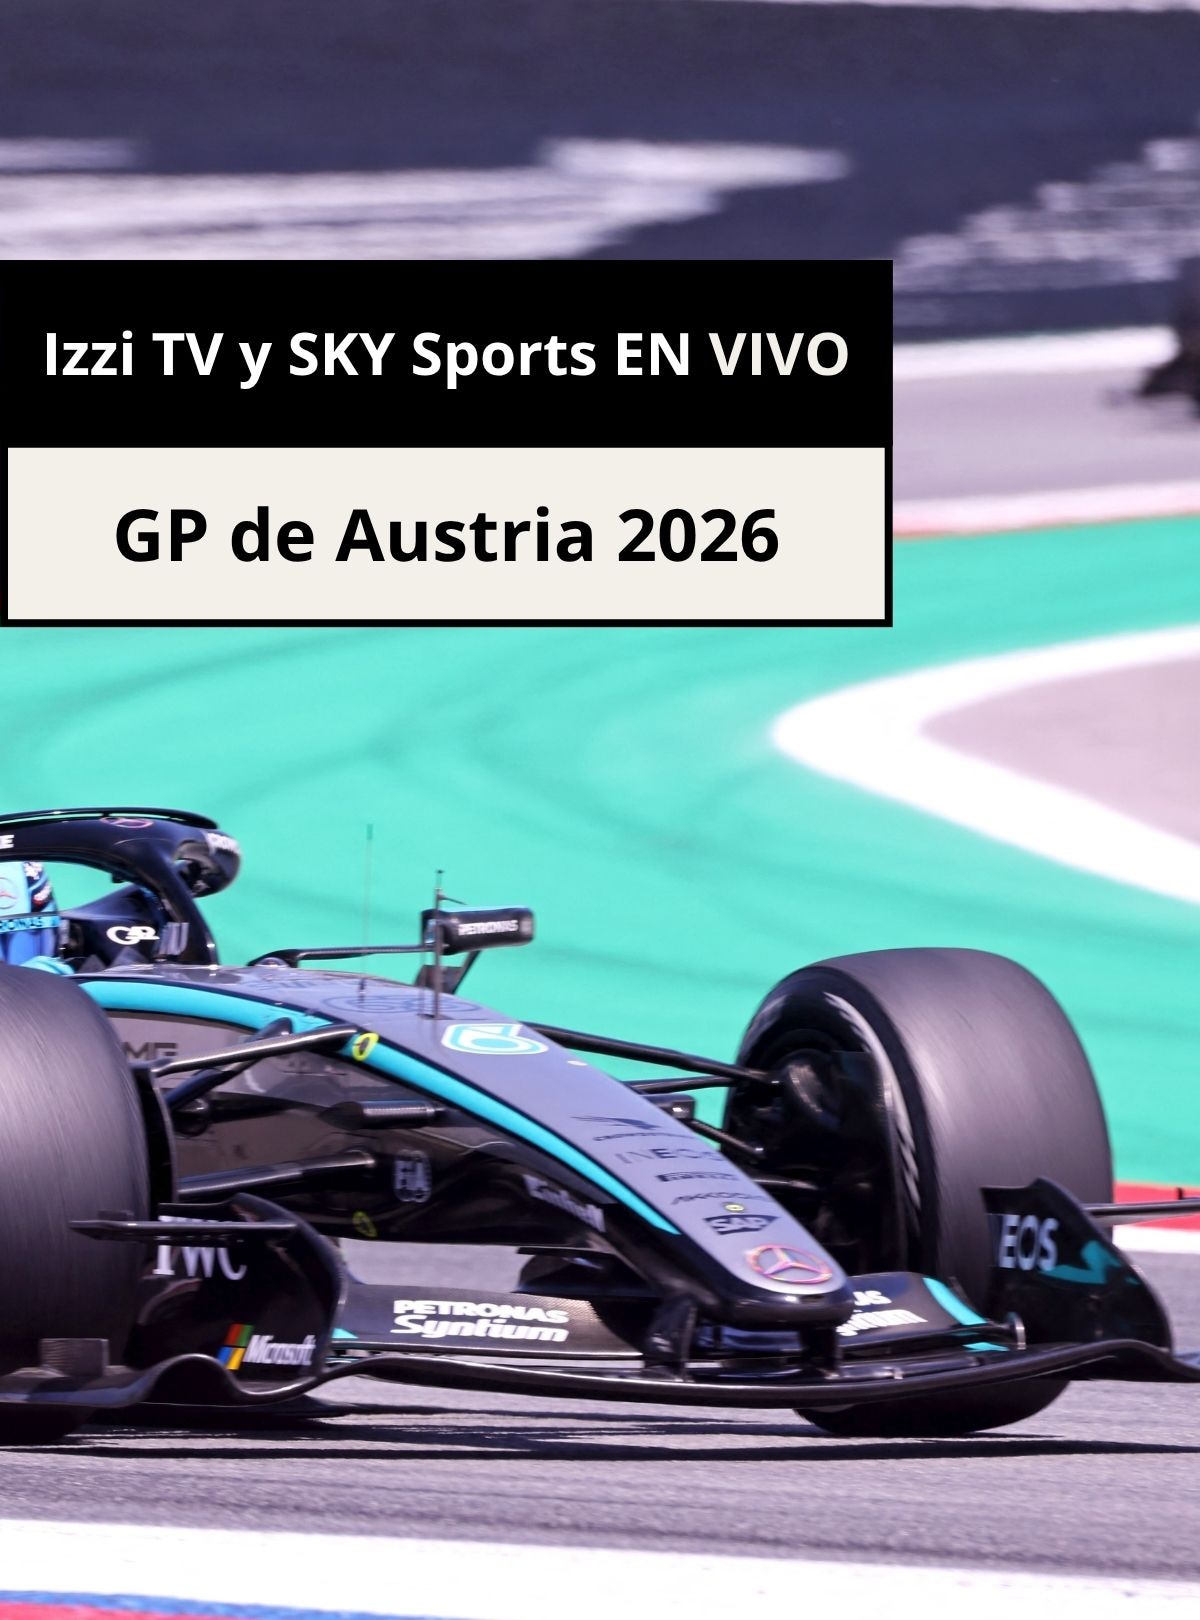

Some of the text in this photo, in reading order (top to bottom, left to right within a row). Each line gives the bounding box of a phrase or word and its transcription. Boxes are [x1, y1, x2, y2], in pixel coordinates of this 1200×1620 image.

[998, 1214, 1059, 1271] EOS
[393, 1299, 570, 1324] PETRONAS
[390, 1313, 570, 1342] Syntium
[242, 1334, 317, 1366] Microsoft
